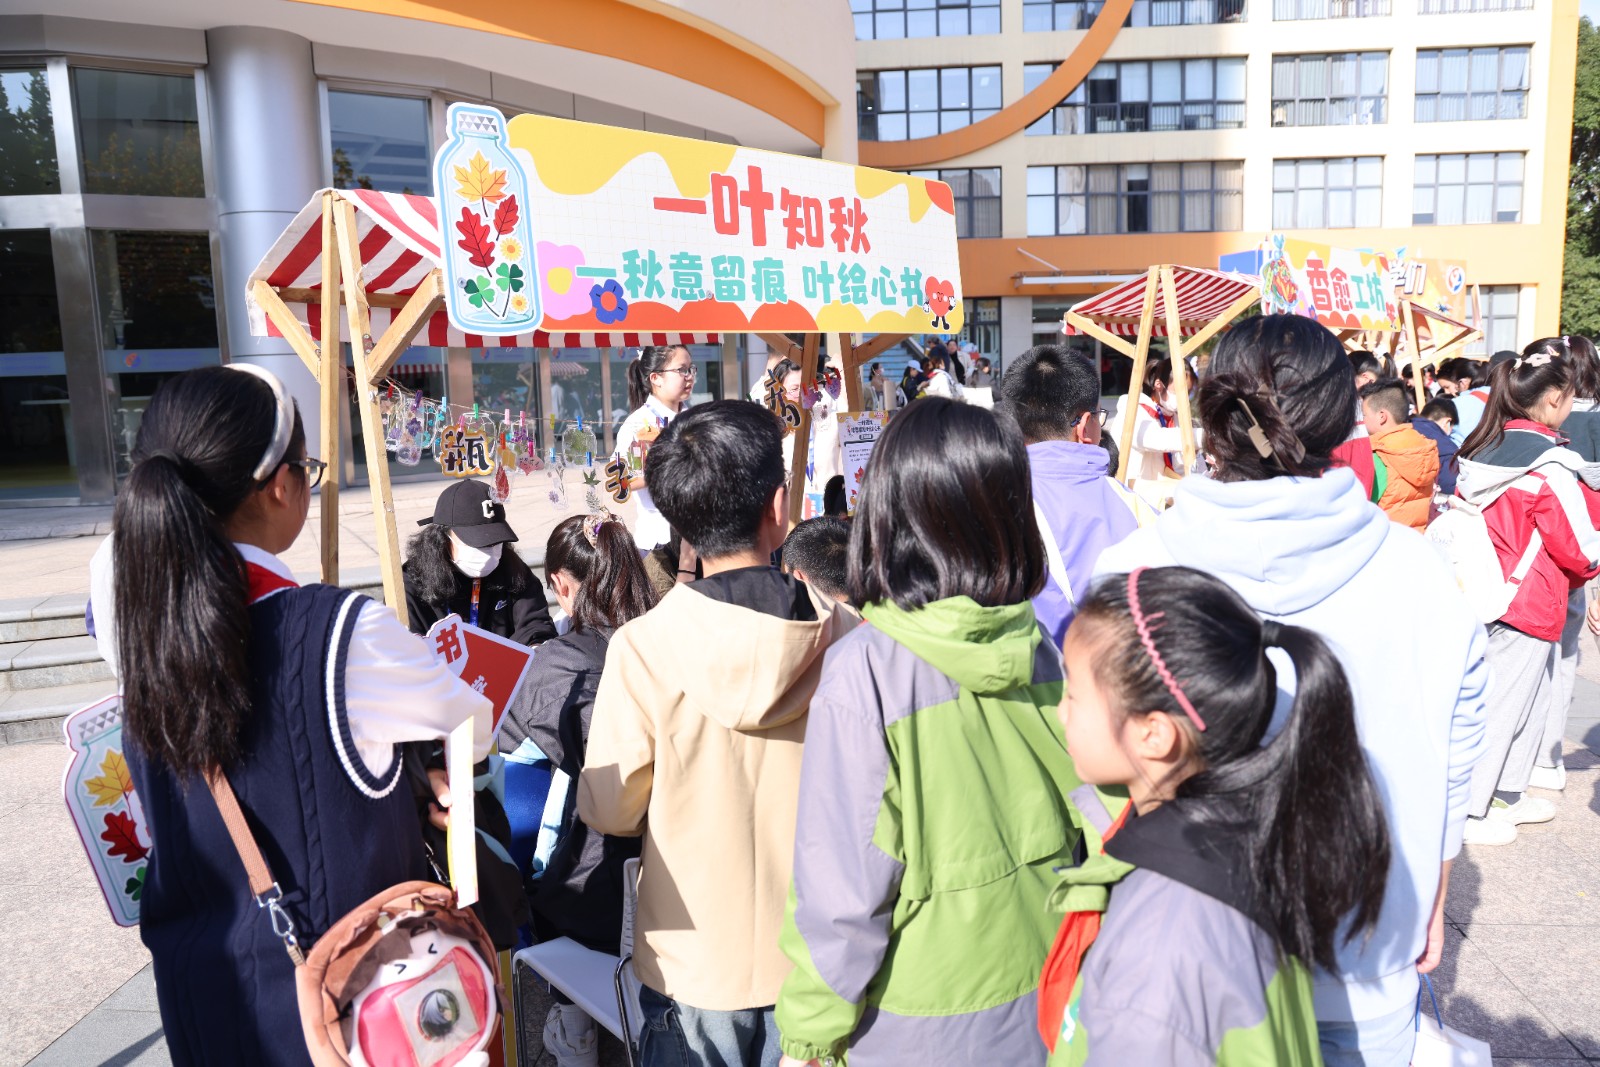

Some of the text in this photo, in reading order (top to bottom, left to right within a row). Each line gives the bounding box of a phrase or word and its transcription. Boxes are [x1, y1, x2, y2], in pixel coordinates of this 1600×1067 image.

[653, 165, 871, 253] 一叶知秋
[576, 249, 924, 307] 一秋意留痕 叶绘心书
[1306, 258, 1386, 312] 香愈工坊
[444, 429, 491, 472] 瓶
[481, 499, 496, 519] C
[436, 622, 462, 664] 书
